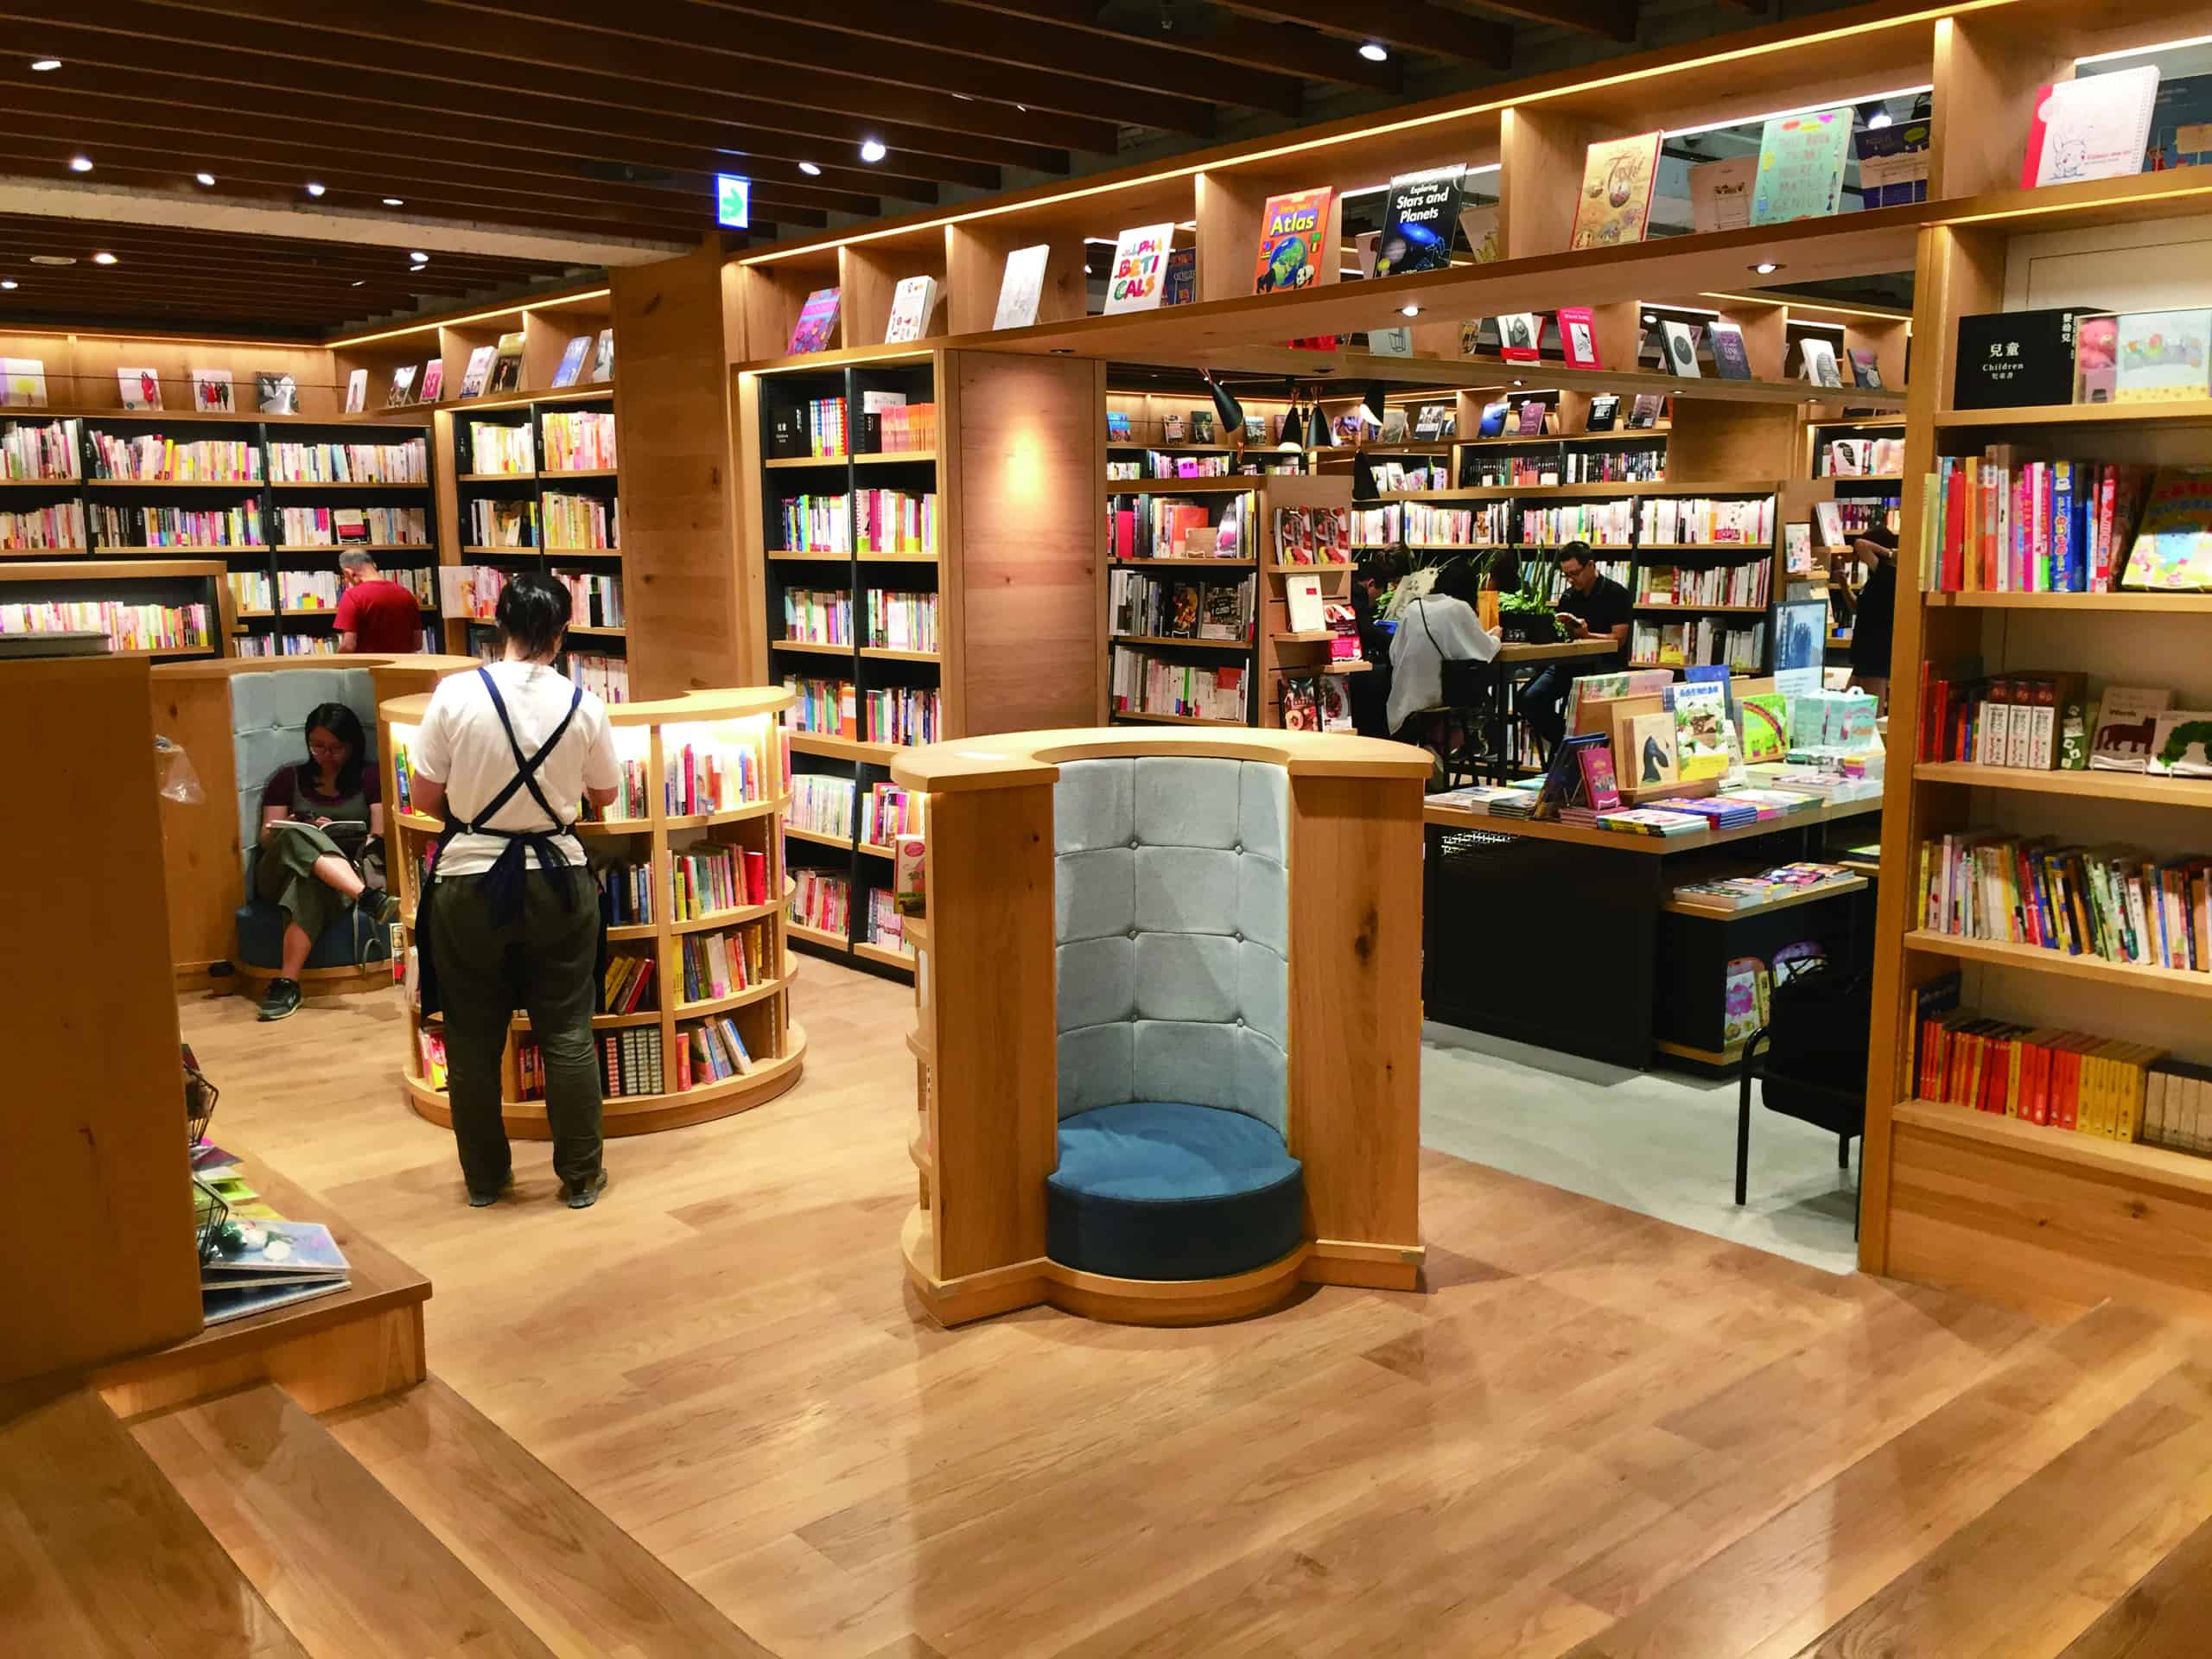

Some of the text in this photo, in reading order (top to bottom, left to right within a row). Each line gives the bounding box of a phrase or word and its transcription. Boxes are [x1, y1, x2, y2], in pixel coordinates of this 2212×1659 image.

[1396, 187, 1449, 209] Stars and
[1410, 184, 1439, 195] Exploring
[1270, 213, 1315, 236] Atlas
[1400, 207, 1439, 224] Planets
[1114, 254, 1160, 279] BETI
[1114, 275, 1156, 301] CALS
[1989, 341, 2020, 358] 兒童
[1982, 363, 2024, 372] Children
